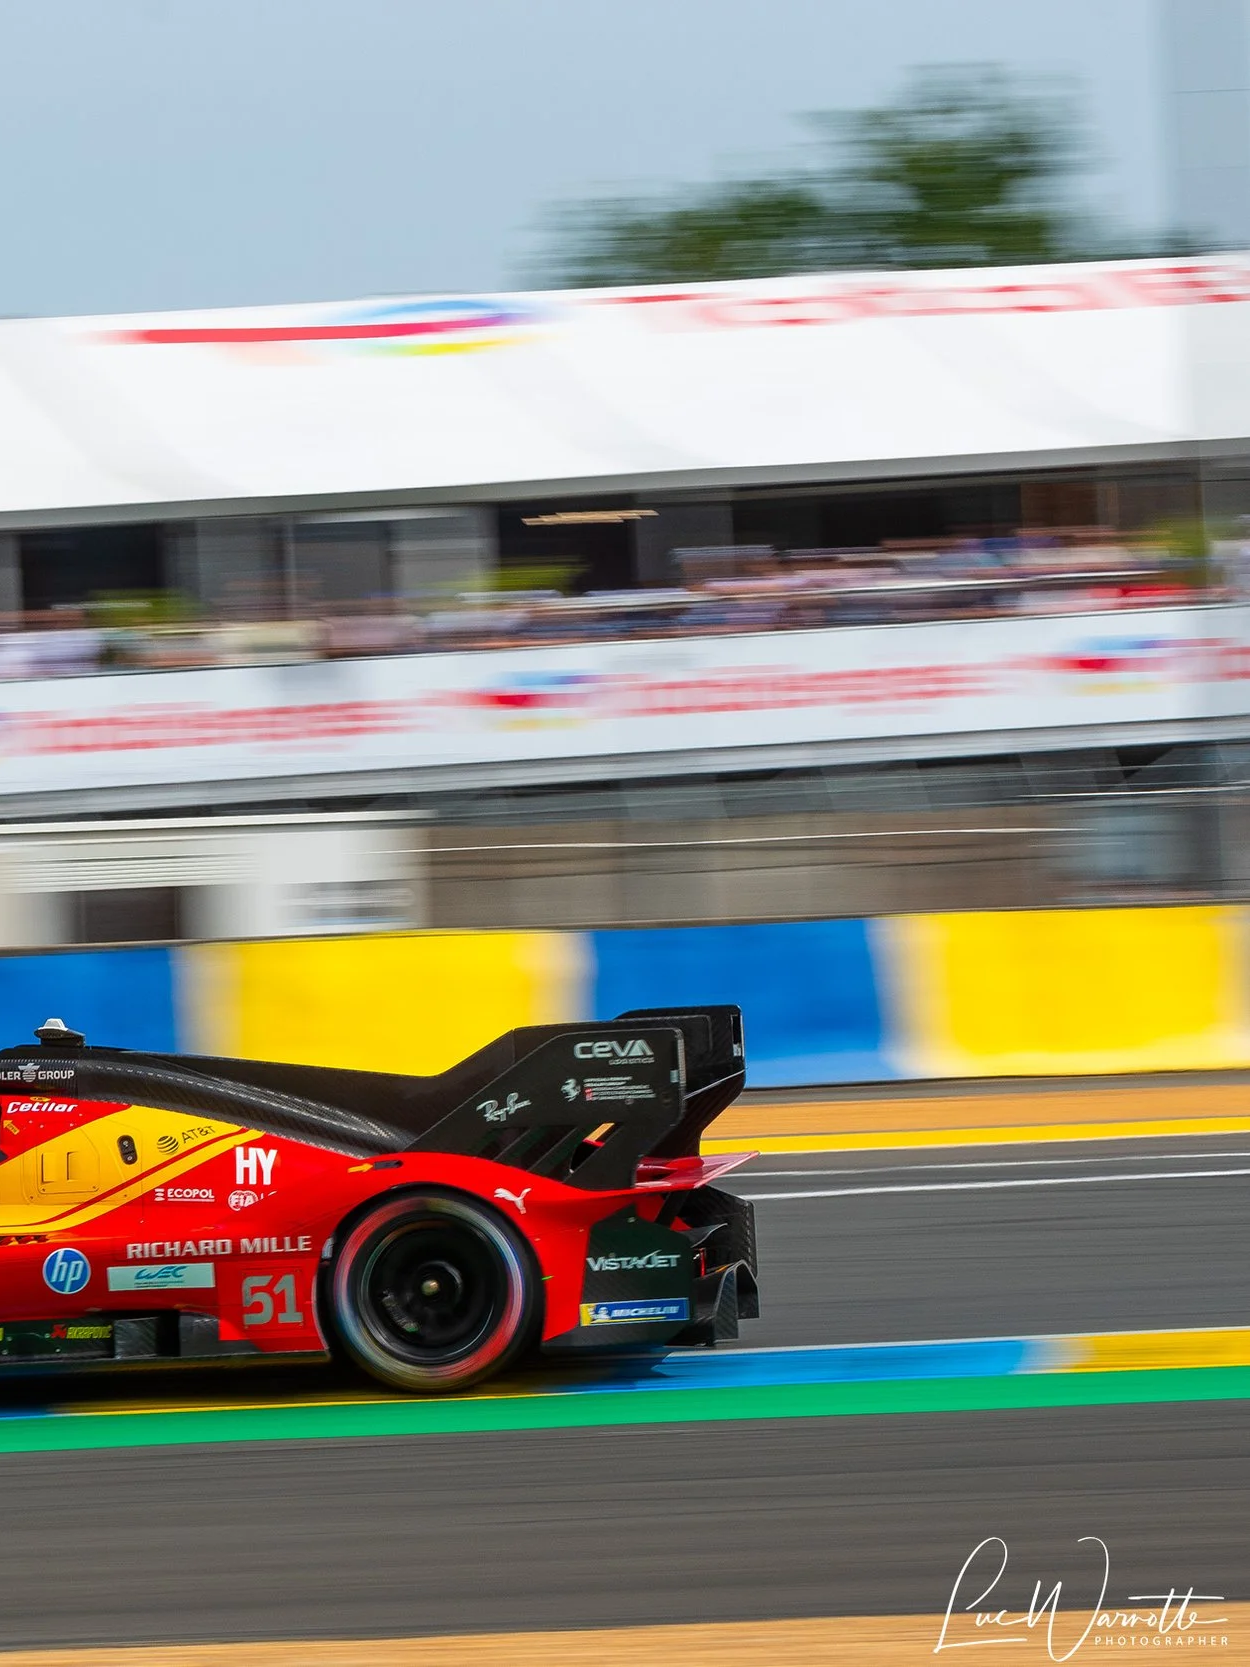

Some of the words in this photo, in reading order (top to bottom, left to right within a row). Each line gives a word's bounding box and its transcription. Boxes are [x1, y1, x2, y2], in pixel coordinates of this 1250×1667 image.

[38, 1070, 75, 1080] GROUP
[7, 1101, 78, 1113] Cetilar
[181, 1125, 217, 1144] AT&T
[235, 1146, 278, 1185] HY
[167, 1188, 215, 1198] ECOPOL
[230, 1194, 255, 1207] FIA
[126, 1239, 232, 1259] RICHARD
[240, 1235, 312, 1254] MILLE
[52, 1249, 81, 1293] hp
[243, 1273, 304, 1330] 51
[611, 1306, 680, 1317] MICHELIN
